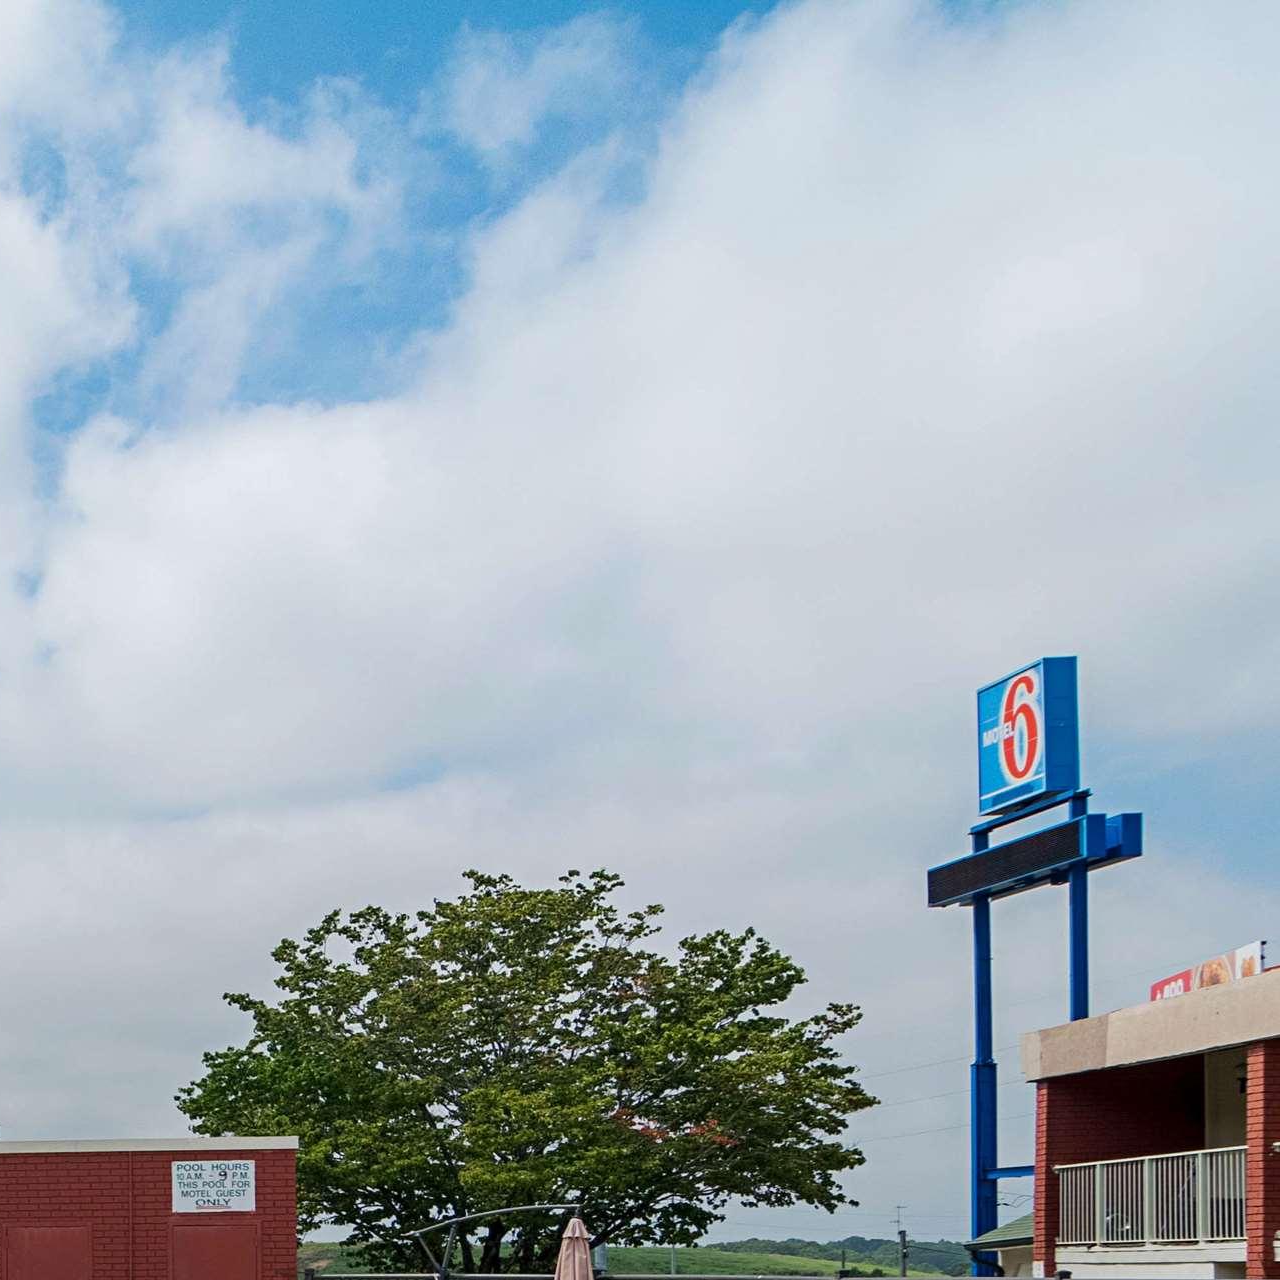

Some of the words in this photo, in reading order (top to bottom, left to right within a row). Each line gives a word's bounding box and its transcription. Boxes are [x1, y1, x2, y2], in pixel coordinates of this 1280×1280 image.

[982, 722, 1015, 748] MOTEL
[1004, 676, 1038, 779] 6
[211, 1163, 250, 1171] HOURS
[218, 1170, 228, 1181] 9
